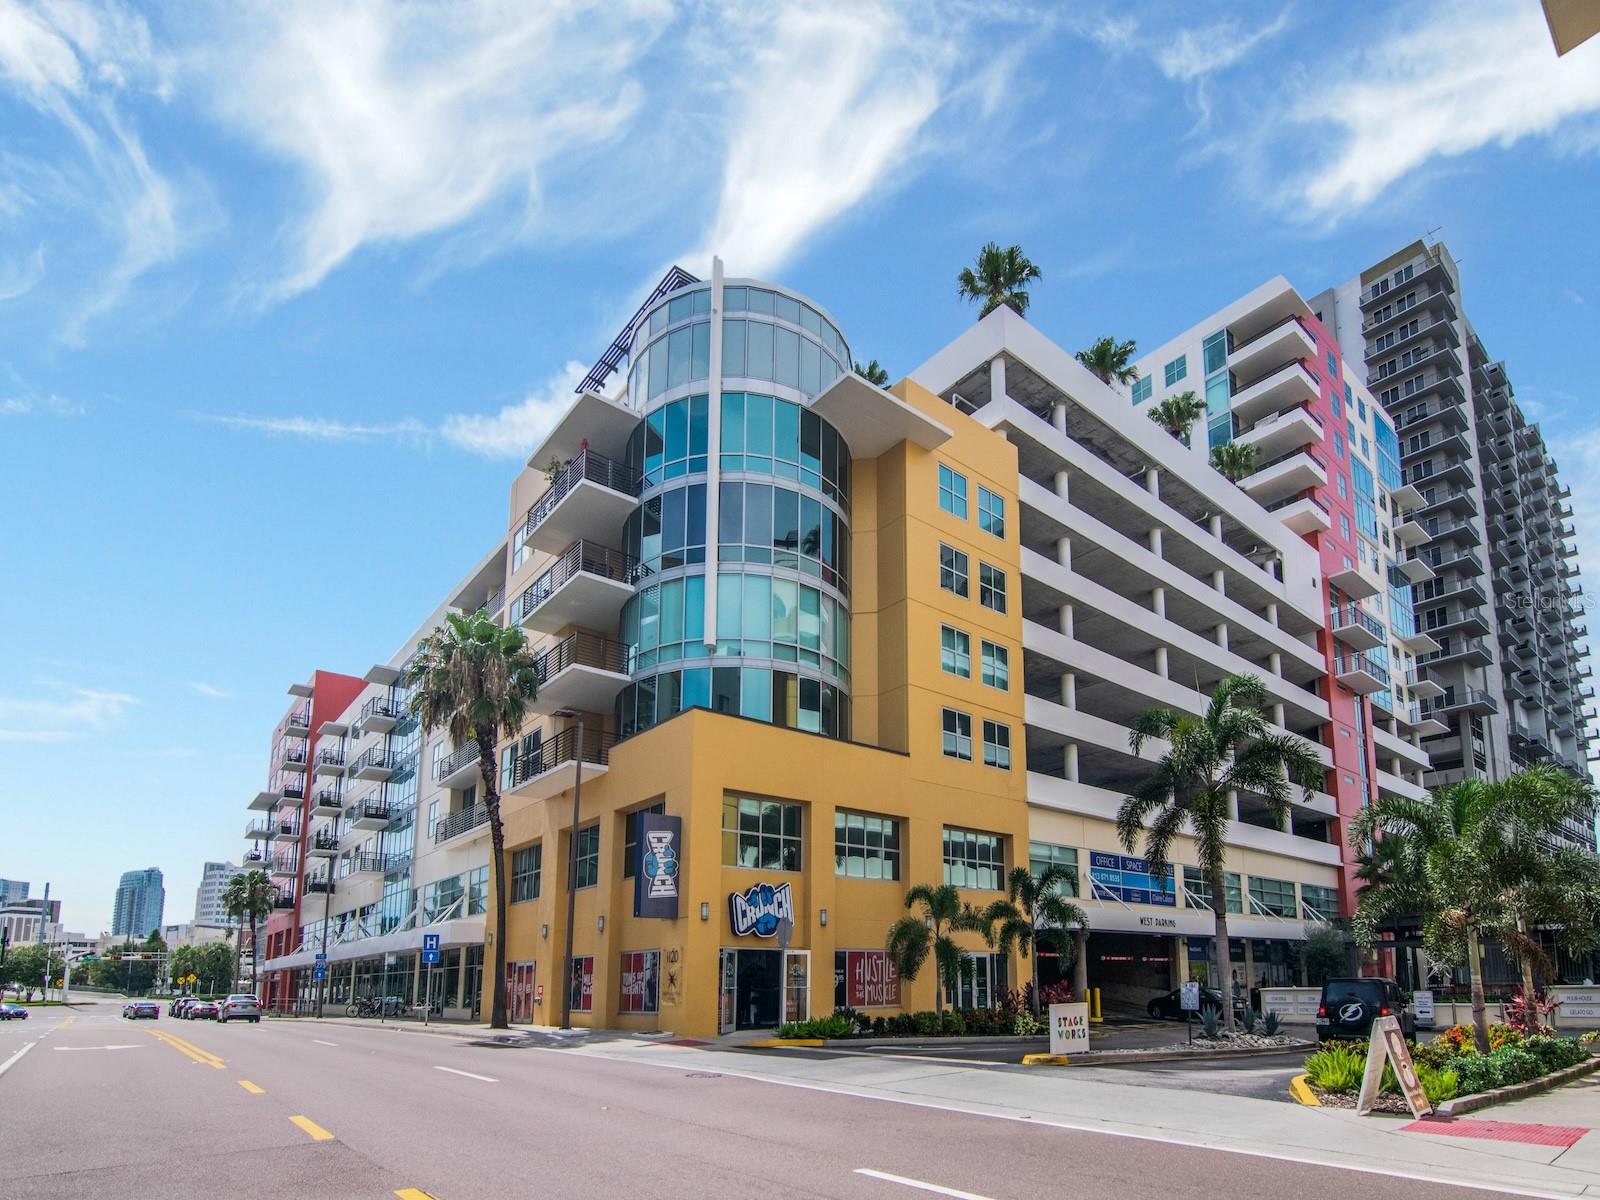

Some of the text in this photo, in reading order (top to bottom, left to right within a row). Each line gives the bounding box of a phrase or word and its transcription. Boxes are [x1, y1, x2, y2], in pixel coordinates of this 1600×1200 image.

[648, 831, 677, 897] CRUNCH
[1096, 856, 1115, 867] OFFICE
[1126, 861, 1142, 871] SPACE
[735, 886, 793, 933] CRUNCH
[1139, 917, 1176, 928] WEST PARKING
[426, 937, 437, 949] H
[856, 955, 897, 983] HUSTLE
[867, 984, 896, 1001] MUSCLE
[1058, 1016, 1084, 1028] STAGE
[1057, 1028, 1086, 1040] WORKS
